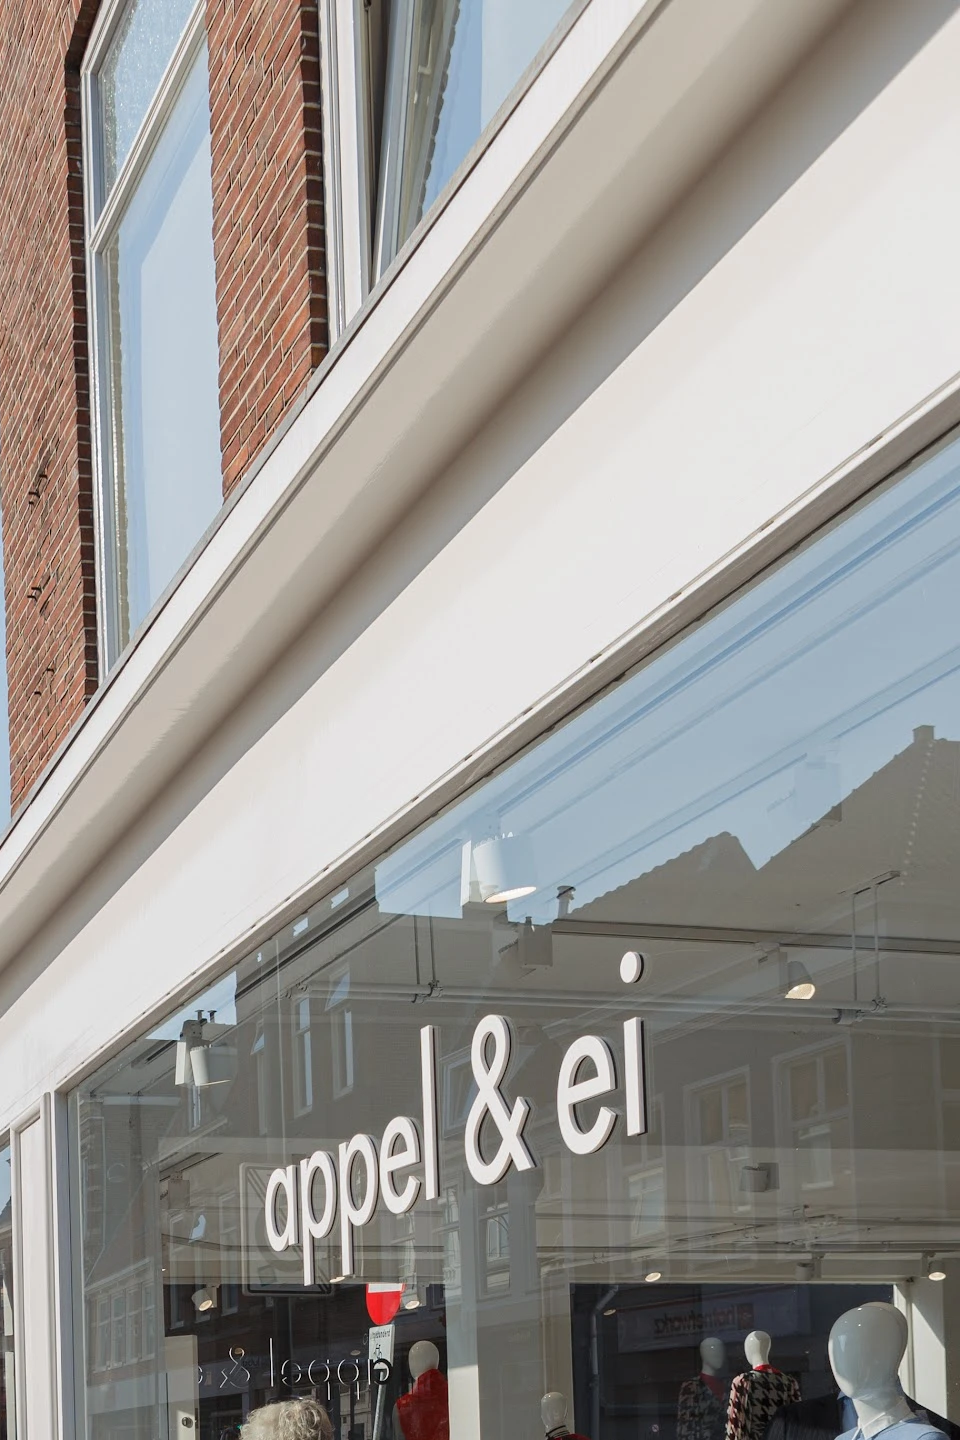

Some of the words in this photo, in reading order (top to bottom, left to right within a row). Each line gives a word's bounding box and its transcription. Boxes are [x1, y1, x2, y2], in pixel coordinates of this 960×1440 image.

[265, 1025, 440, 1286] appel
[465, 1015, 538, 1185] &
[557, 951, 648, 1155] ei
